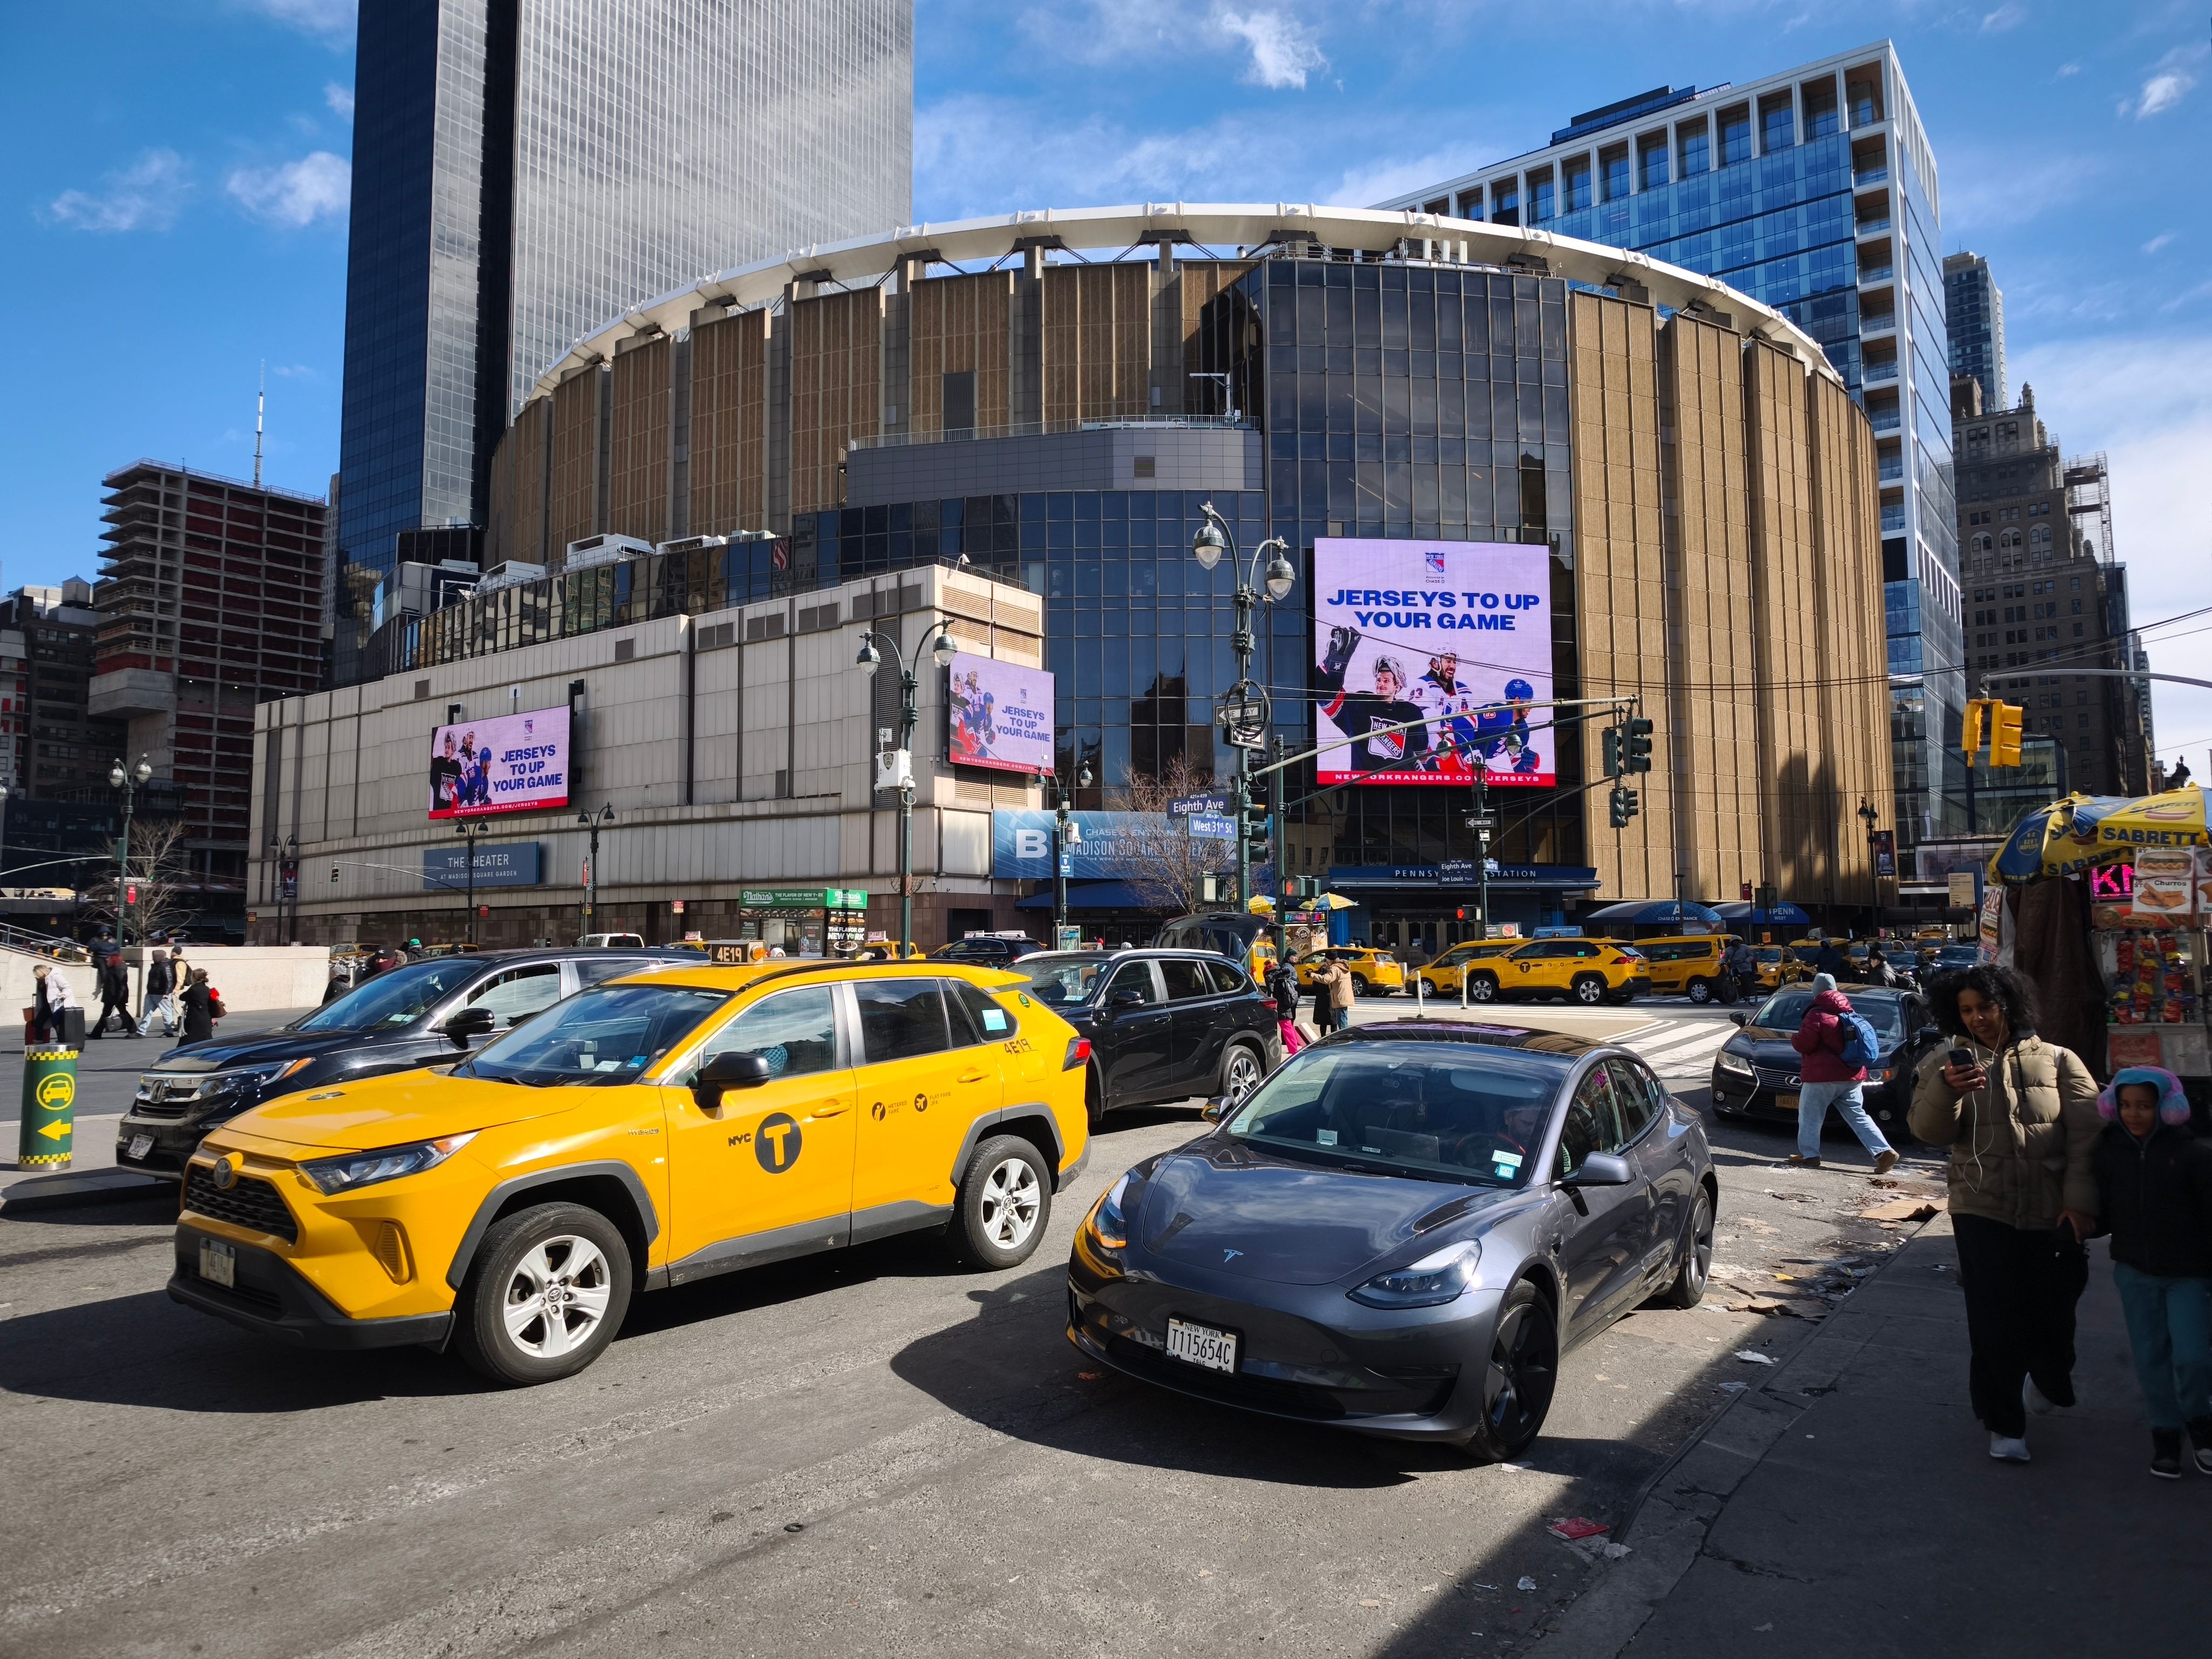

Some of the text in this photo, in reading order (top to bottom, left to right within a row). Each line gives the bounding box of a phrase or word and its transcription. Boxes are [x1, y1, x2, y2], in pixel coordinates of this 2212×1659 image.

[1327, 590, 1540, 610] JERSEYS TO UP
[1354, 611, 1515, 630] YOUR GAME
[1001, 705, 1045, 720] JERSEYS
[1009, 717, 1037, 729] TO UP
[996, 725, 1050, 742] YOUR GAME
[1378, 733, 1401, 756] ANGERS
[501, 744, 556, 763] JERSEYS
[510, 760, 545, 775] TO UP
[493, 773, 563, 792] YOUR GAME
[1174, 799, 1224, 814] Eighth Ave
[1085, 828, 1117, 837] CHASE
[1193, 819, 1232, 834] West 31st St
[1016, 829, 1048, 858] B
[2103, 826, 2201, 846] SABRETT
[448, 854, 509, 868] THE HEATER
[1490, 869, 1536, 878] STATION
[744, 891, 774, 901] Nathan's
[835, 891, 861, 901] Nathan's
[717, 947, 741, 962] 4E19
[1004, 1038, 1032, 1055] 4E19
[728, 1123, 791, 1166] NYC T
[1185, 1323, 1220, 1339] NEW YORK
[1172, 1329, 1231, 1365] T115654C
